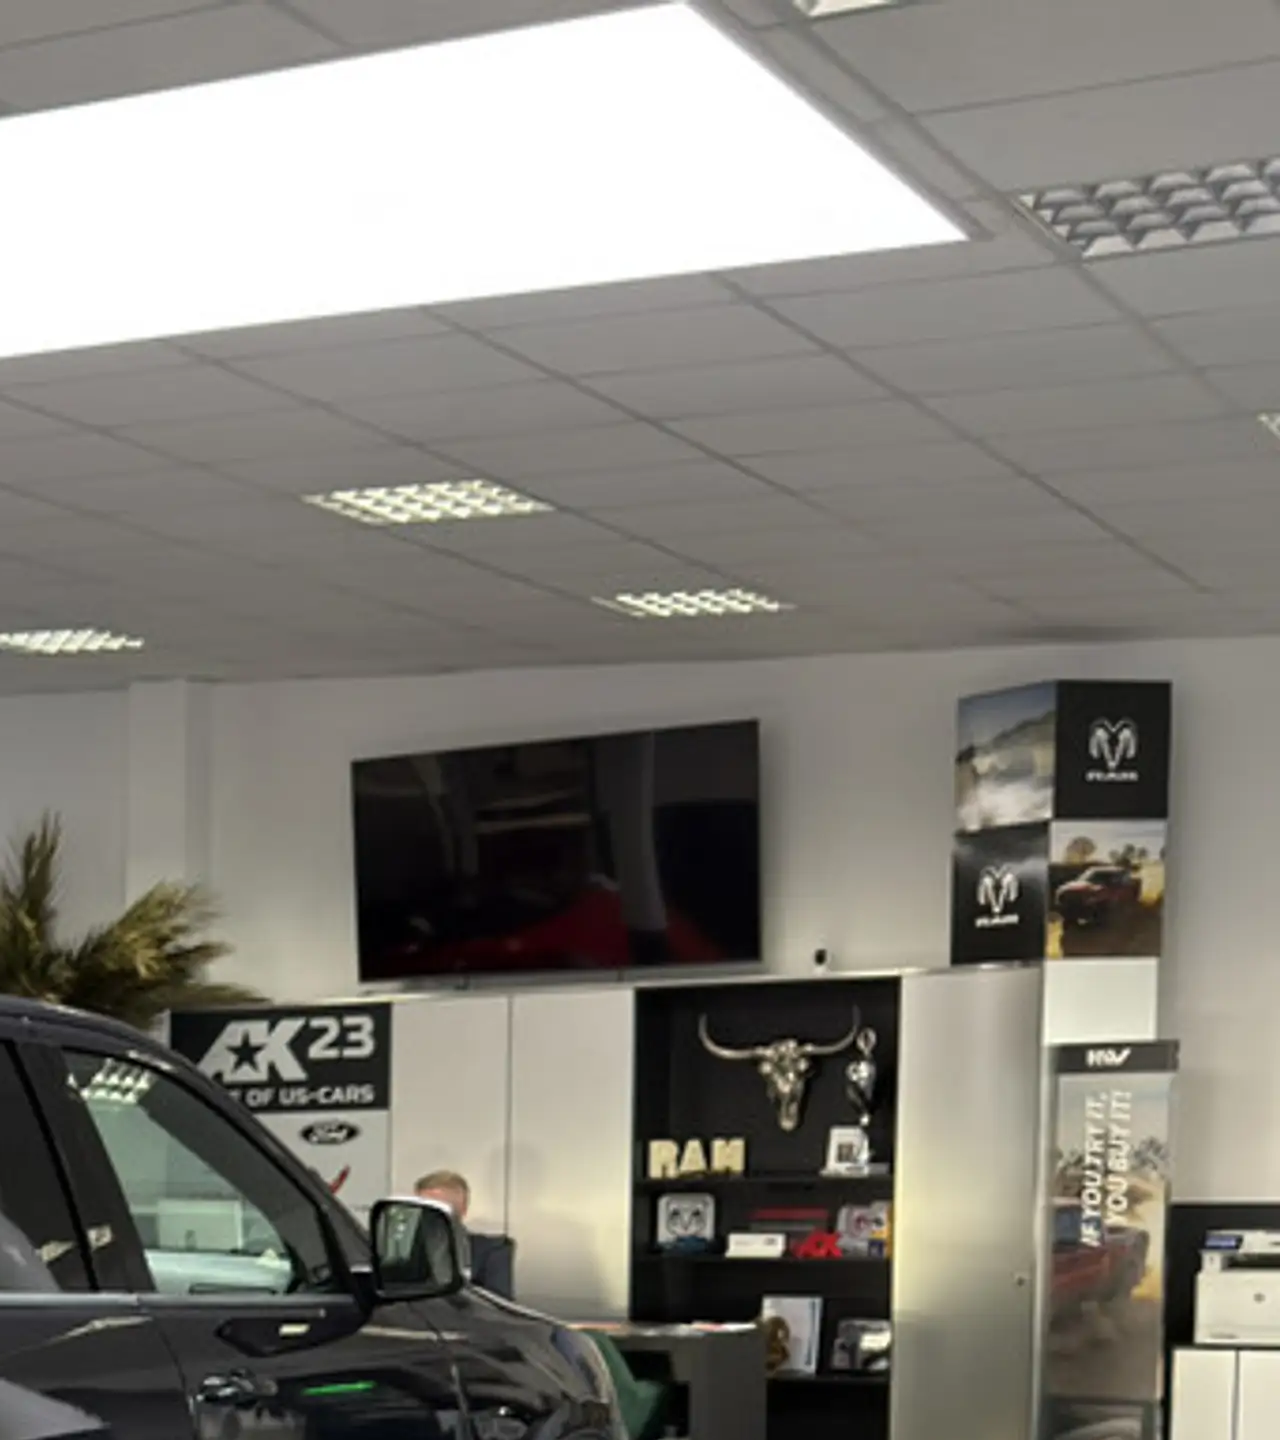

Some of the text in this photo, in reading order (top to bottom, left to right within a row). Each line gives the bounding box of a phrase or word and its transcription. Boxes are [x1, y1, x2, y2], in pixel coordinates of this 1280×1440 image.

[246, 1086, 274, 1108] OF
[279, 1083, 375, 1106] US-CARS
[648, 1137, 746, 1179] RAM
[1083, 1123, 1105, 1169] TRY
[1106, 1123, 1131, 1173] BUY
[1080, 1169, 1103, 1222] YOU
[1104, 1174, 1129, 1227] YOU
[1080, 1222, 1102, 1248] IF
